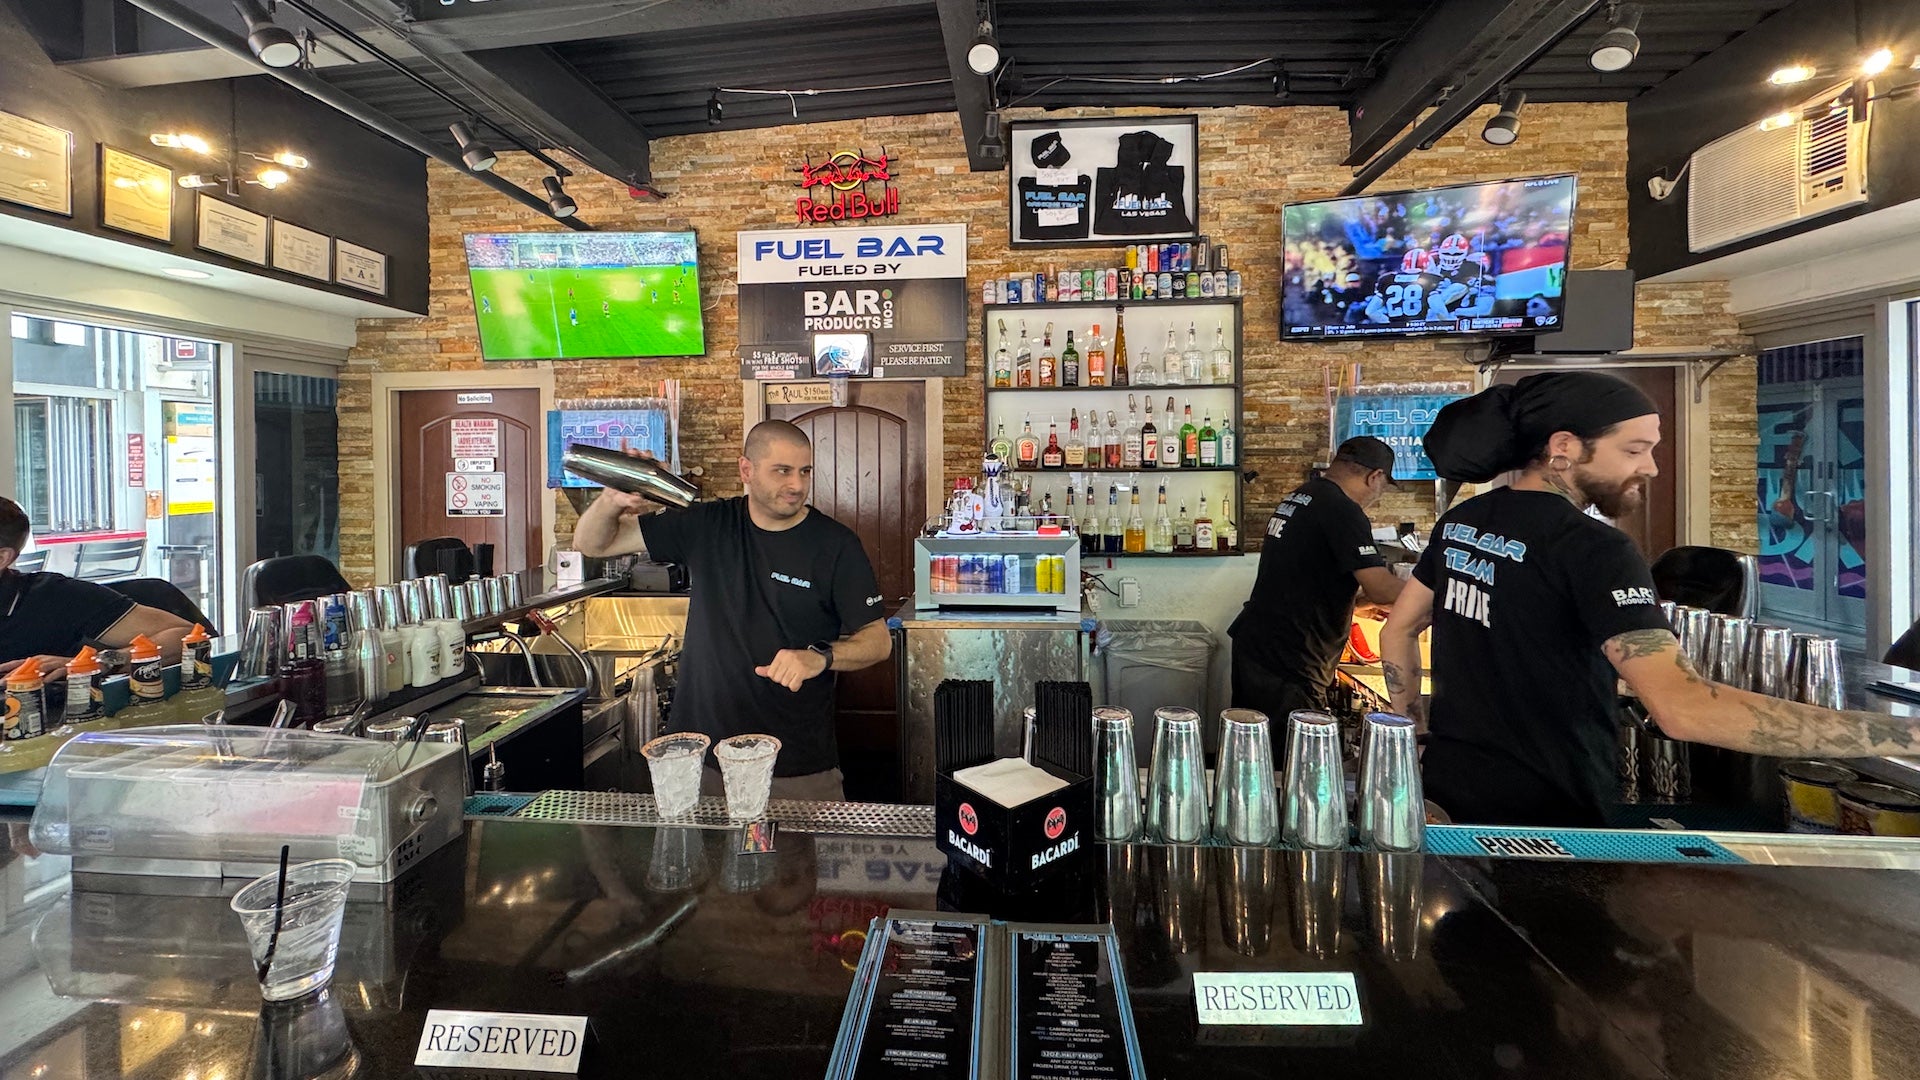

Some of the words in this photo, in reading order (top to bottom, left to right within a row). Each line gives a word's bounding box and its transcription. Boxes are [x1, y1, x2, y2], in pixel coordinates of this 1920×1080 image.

[1025, 191, 1056, 201] FUEL
[1058, 192, 1086, 202] BAR
[797, 192, 845, 222] Red
[850, 187, 899, 219] Bull
[755, 239, 844, 261] FUEL
[857, 235, 945, 258] BAR
[357, 270, 365, 279] A
[798, 263, 867, 277] FUELED
[873, 263, 901, 274] BY
[804, 290, 881, 316] BAR
[1385, 284, 1424, 318] 28
[805, 316, 882, 330] PRODUCTS
[753, 351, 761, 359] $5
[889, 343, 921, 354] SERVICE
[922, 343, 945, 353] FIRST
[764, 356, 779, 365] FREE
[881, 356, 909, 366] PLEASE
[908, 356, 920, 365] BE
[919, 355, 953, 365] PATIENT
[466, 395, 492, 403] Soliciting
[473, 420, 495, 428] WARNING
[1354, 409, 1407, 425] FUEL
[562, 424, 604, 439] FUEL
[607, 424, 650, 439] BAR
[1376, 436, 1423, 446] ISTIA
[1146, 441, 1158, 459] 7
[1442, 522, 1479, 546] FUEL
[1475, 533, 1527, 563] BAR
[1443, 547, 1495, 586] TEAM
[1611, 587, 1652, 602] BAR
[949, 829, 992, 868] BACARDÍ
[1031, 830, 1080, 870] BACARDÍ
[1473, 835, 1575, 859] PRIME
[1202, 985, 1351, 1011] RESERVED
[425, 1024, 577, 1057] RESERVED
